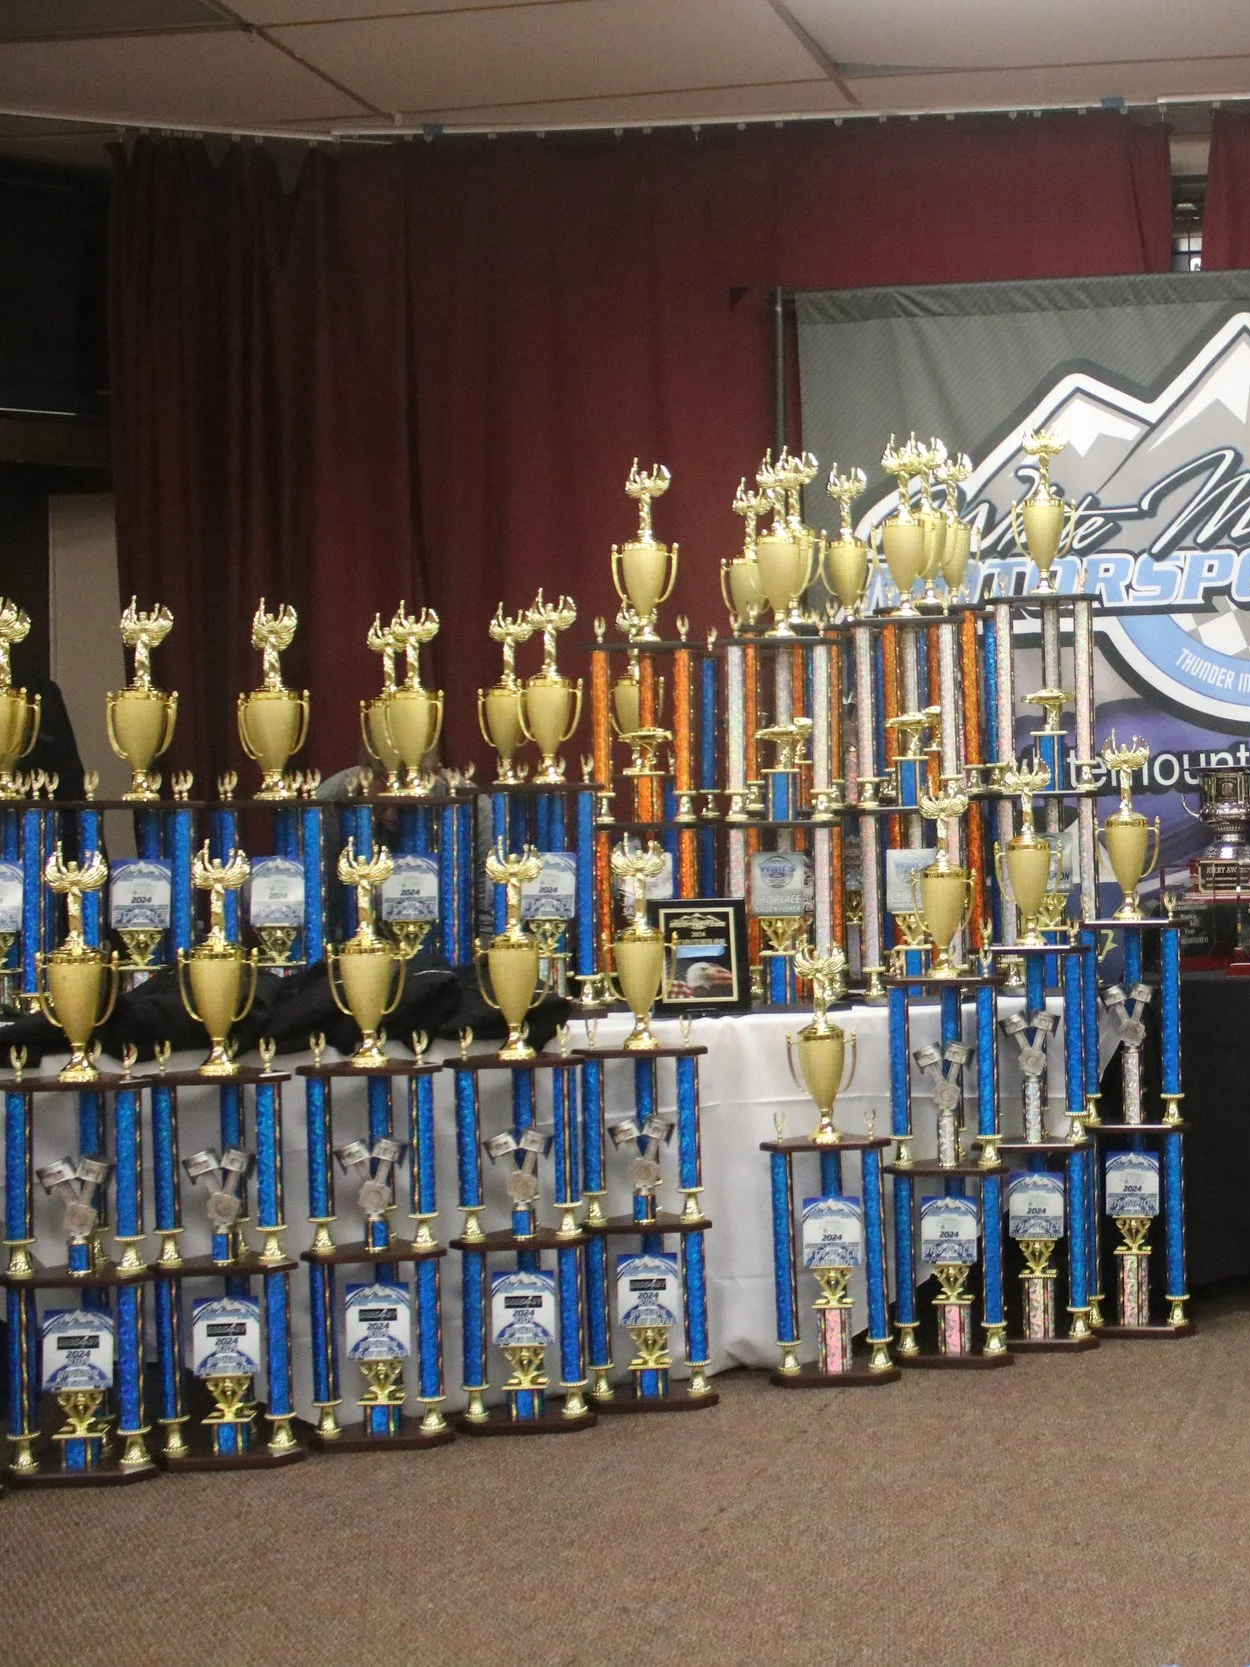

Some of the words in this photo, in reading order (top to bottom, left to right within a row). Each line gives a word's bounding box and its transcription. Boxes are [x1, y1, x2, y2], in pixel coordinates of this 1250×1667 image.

[1175, 647, 1234, 690] THUNDER
[1122, 1184, 1142, 1192] 2024
[1026, 1207, 1047, 1215] 2024
[821, 1233, 843, 1241] 2024
[939, 1231, 959, 1239] 2024
[637, 1291, 659, 1300] 2024
[511, 1309, 535, 1317] 2024
[366, 1322, 390, 1331] 2024
[214, 1337, 239, 1346] 2024
[66, 1350, 91, 1359] 2024
